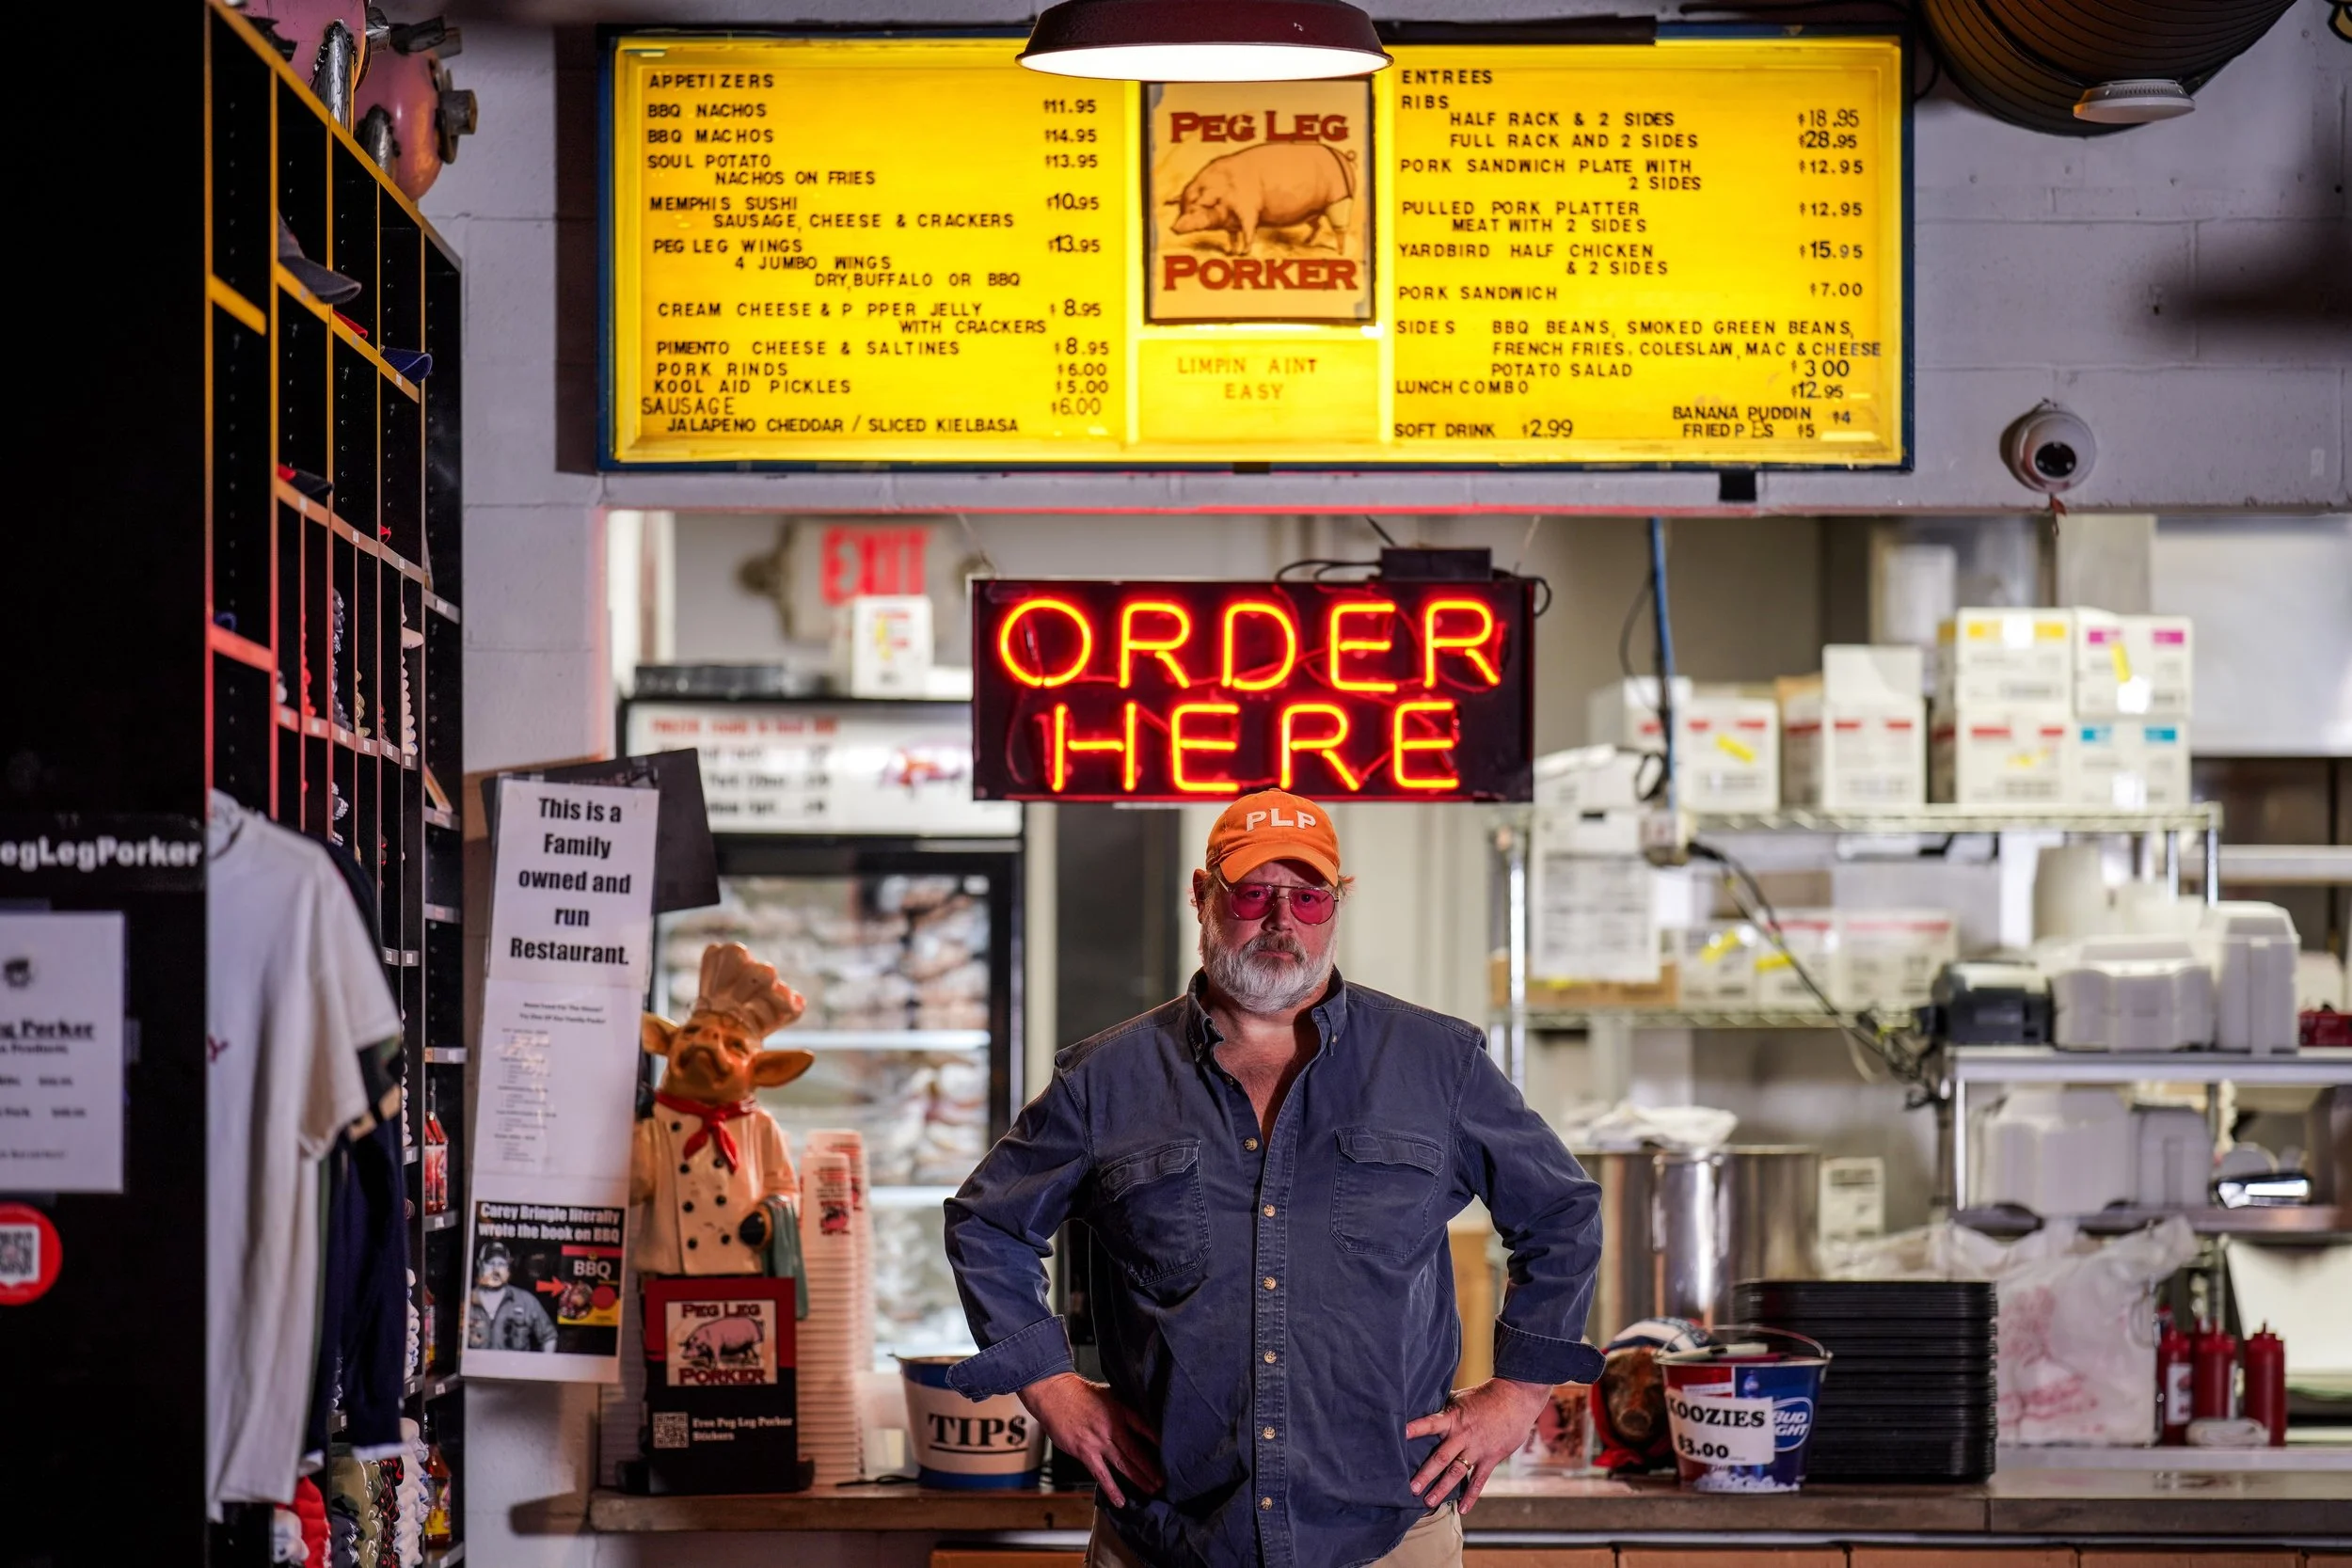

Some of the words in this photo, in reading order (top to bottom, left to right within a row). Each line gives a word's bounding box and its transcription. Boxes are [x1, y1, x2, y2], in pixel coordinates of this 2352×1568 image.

[647, 72, 774, 89] APPETIZERS
[1401, 69, 1493, 85] ENTREES
[1401, 94, 1450, 110] RIBS
[646, 103, 681, 119] BBQ
[695, 103, 767, 119] NACHOS
[1450, 111, 1497, 127] HALF
[1508, 111, 1559, 127] RACK
[1573, 111, 1585, 127] &
[1598, 112, 1610, 127] 2
[1624, 111, 1675, 127] SIDES
[1170, 112, 1257, 143] PEG
[1265, 111, 1349, 142] LEG
[646, 128, 683, 145] BBQ
[694, 128, 774, 144] MACHOS
[1450, 133, 1495, 149] FULL
[1507, 133, 1560, 148] RACK
[1571, 133, 1610, 149] AND
[1621, 133, 1631, 149] 2
[1641, 133, 1698, 149] SIDES
[645, 153, 694, 170] SOUL
[705, 153, 771, 168] POTATO
[1400, 158, 1452, 173] PORK
[1467, 158, 1565, 173] SANDWICH
[1579, 158, 1633, 174] PLATE
[1645, 159, 1692, 174] WITH
[715, 170, 785, 186] NACHOS
[794, 170, 818, 185] ON
[827, 170, 876, 185] FRIES
[1629, 176, 1639, 191] 2
[1648, 175, 1702, 191] SIDES
[648, 196, 731, 212] MEMPHIS
[744, 196, 798, 212] SUSHI
[1402, 200, 1475, 215] PULLED
[1491, 200, 1541, 215] PORK
[1555, 200, 1639, 216] PLATTER
[712, 213, 802, 231] SAUSAGE,
[808, 213, 881, 229] CHEESE
[896, 214, 907, 229] &
[917, 213, 1014, 229] CRACKERS
[1452, 217, 1500, 232] MEAT
[1508, 218, 1552, 232] WITH
[1566, 218, 1576, 233] 2
[1591, 218, 1646, 233] SIDES
[653, 238, 685, 254] PEG
[692, 238, 729, 254] LEG
[740, 238, 803, 254] WINGS
[1398, 243, 1490, 259] YARDBIRD
[1510, 243, 1554, 259] HALF
[1569, 244, 1653, 259] CHICKEN
[735, 256, 745, 270] 4
[758, 255, 818, 271] JUMBO
[834, 255, 891, 271] WINGS
[1565, 261, 1577, 276] &
[1589, 261, 1598, 276] 2
[1609, 261, 1668, 276] SIDES
[948, 272, 971, 287] OR
[987, 272, 1021, 287] BBQ
[1164, 255, 1359, 291] PORKER
[1398, 285, 1448, 300] PORK
[1460, 285, 1557, 300] SANDWICH
[657, 302, 722, 318] CREAM
[737, 302, 811, 317] CHEESE
[819, 302, 831, 317] &
[930, 302, 982, 317] JELLY
[898, 319, 942, 334] WITH
[955, 319, 1047, 335] CRACKERS
[1396, 320, 1455, 335] SIDES
[1492, 320, 1529, 335] BBQ
[1627, 320, 1703, 335] SMOKED
[1713, 320, 1775, 335] GREEN
[655, 340, 730, 356] PIMENTO
[752, 341, 826, 356] CHEESE
[840, 341, 851, 356] &
[866, 341, 960, 356] SALTINES
[1493, 341, 1563, 356] FRENCH
[1745, 341, 1786, 356] MAC
[1796, 341, 1806, 356] &
[1812, 341, 1882, 357] CHEESE
[656, 361, 711, 377] PORK
[726, 361, 788, 377] RINDS
[1177, 357, 1246, 375] LIMPIN
[1268, 359, 1318, 375] AINT
[1491, 362, 1561, 377] POTATO
[1570, 362, 1632, 377] SALAD
[653, 378, 705, 394] KOOL
[718, 379, 751, 394] AID
[770, 379, 850, 394] PICKLES
[1225, 383, 1284, 401] EASY
[1395, 379, 1454, 395] LUNCH
[1459, 380, 1529, 395] COMBO
[641, 395, 735, 417] SAUSAGE
[1673, 406, 1739, 420] BANANA
[1748, 406, 1811, 420] PUDDIN
[665, 417, 756, 434] JALAPENO
[766, 418, 844, 433] CHEDDAR
[867, 418, 927, 433] SLICED
[936, 418, 1019, 433] KIELBASA
[1393, 422, 1437, 438] SOFT
[1444, 422, 1496, 437] DRINK
[1683, 423, 1729, 437] FRIED
[998, 597, 1503, 692] ORDER
[1050, 699, 1461, 793] HERE
[539, 798, 580, 820] This
[586, 801, 604, 821] is
[610, 808, 621, 823] a
[1246, 809, 1316, 832] PLP
[544, 833, 611, 859] Family
[519, 870, 586, 892] owned
[593, 874, 630, 894] and
[554, 908, 590, 927] run
[510, 938, 629, 965] Restaurant.
[573, 1260, 612, 1279] BBQ
[678, 1368, 766, 1385] PORKER
[1678, 1433, 1729, 1458] $3.00
